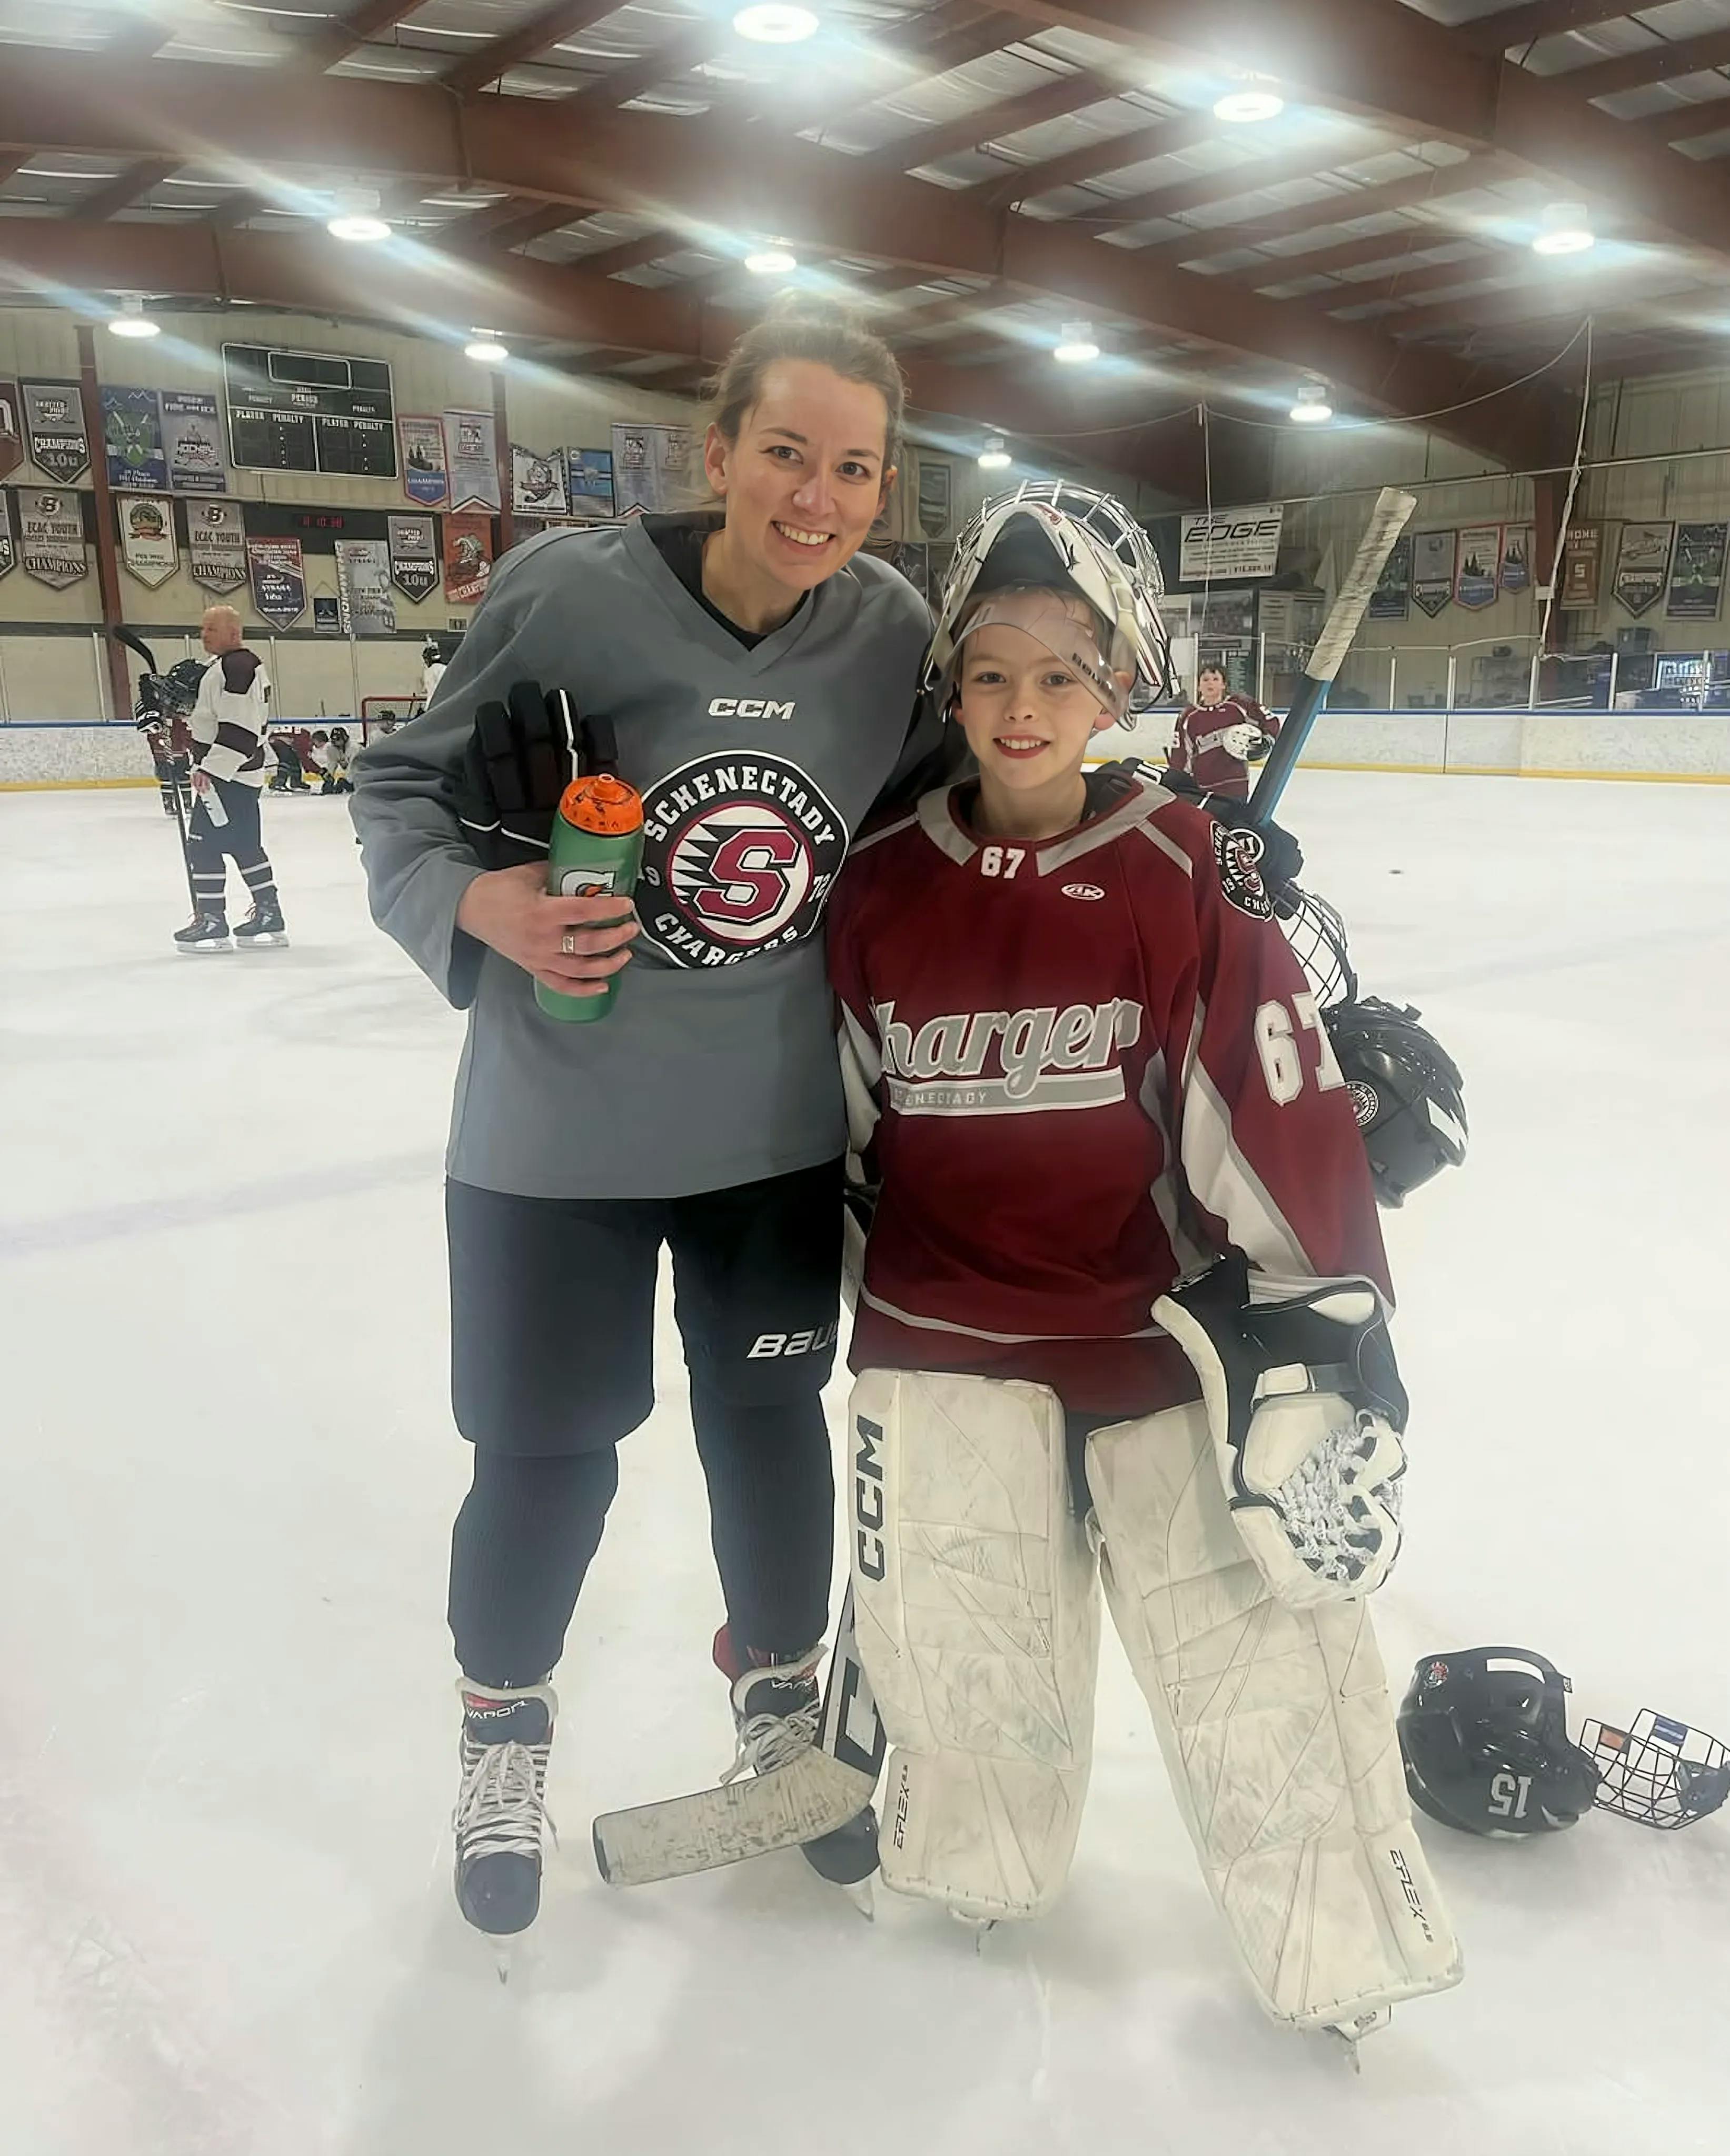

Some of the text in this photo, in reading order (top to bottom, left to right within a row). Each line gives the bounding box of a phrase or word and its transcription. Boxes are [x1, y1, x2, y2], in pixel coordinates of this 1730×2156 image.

[1184, 519, 1281, 542] EDGE
[708, 697, 796, 720] CCM
[644, 765, 835, 845] SCHENECTADY
[693, 829, 799, 922] S
[980, 846, 1026, 879] 67
[1255, 991, 1346, 1106] 67
[856, 1415, 885, 1581] CCM
[1488, 1772, 1532, 1819] 15
